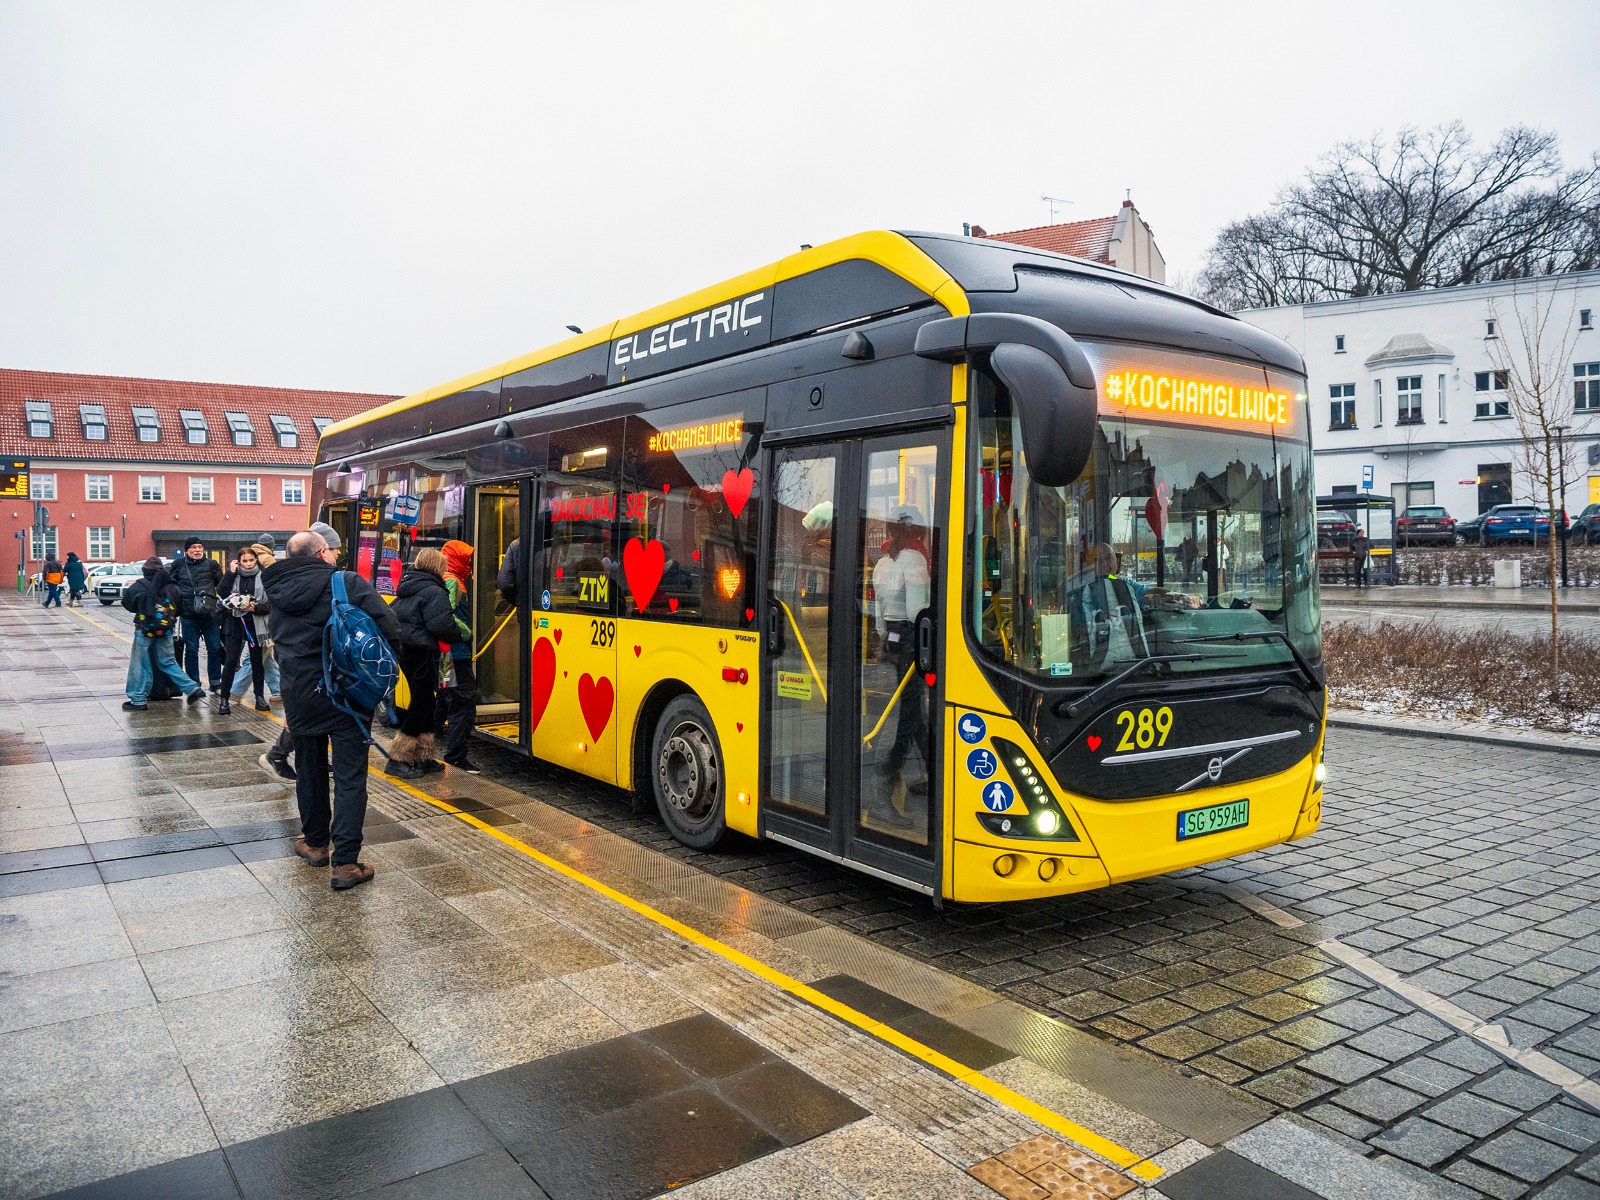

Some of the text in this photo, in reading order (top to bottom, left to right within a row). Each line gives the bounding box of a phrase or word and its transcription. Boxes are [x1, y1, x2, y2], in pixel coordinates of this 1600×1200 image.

[614, 292, 764, 365] ELECTRIC
[1105, 372, 1288, 424] #KOCHAMGLIWICE
[648, 419, 743, 453] #KOCHAMGLIWICE
[550, 493, 645, 523] ZAKOCHAJ SIĘ
[579, 574, 608, 603] ZTM
[591, 619, 616, 648] 289
[1116, 706, 1174, 752] 289
[1188, 803, 1246, 833] SG 959AH
